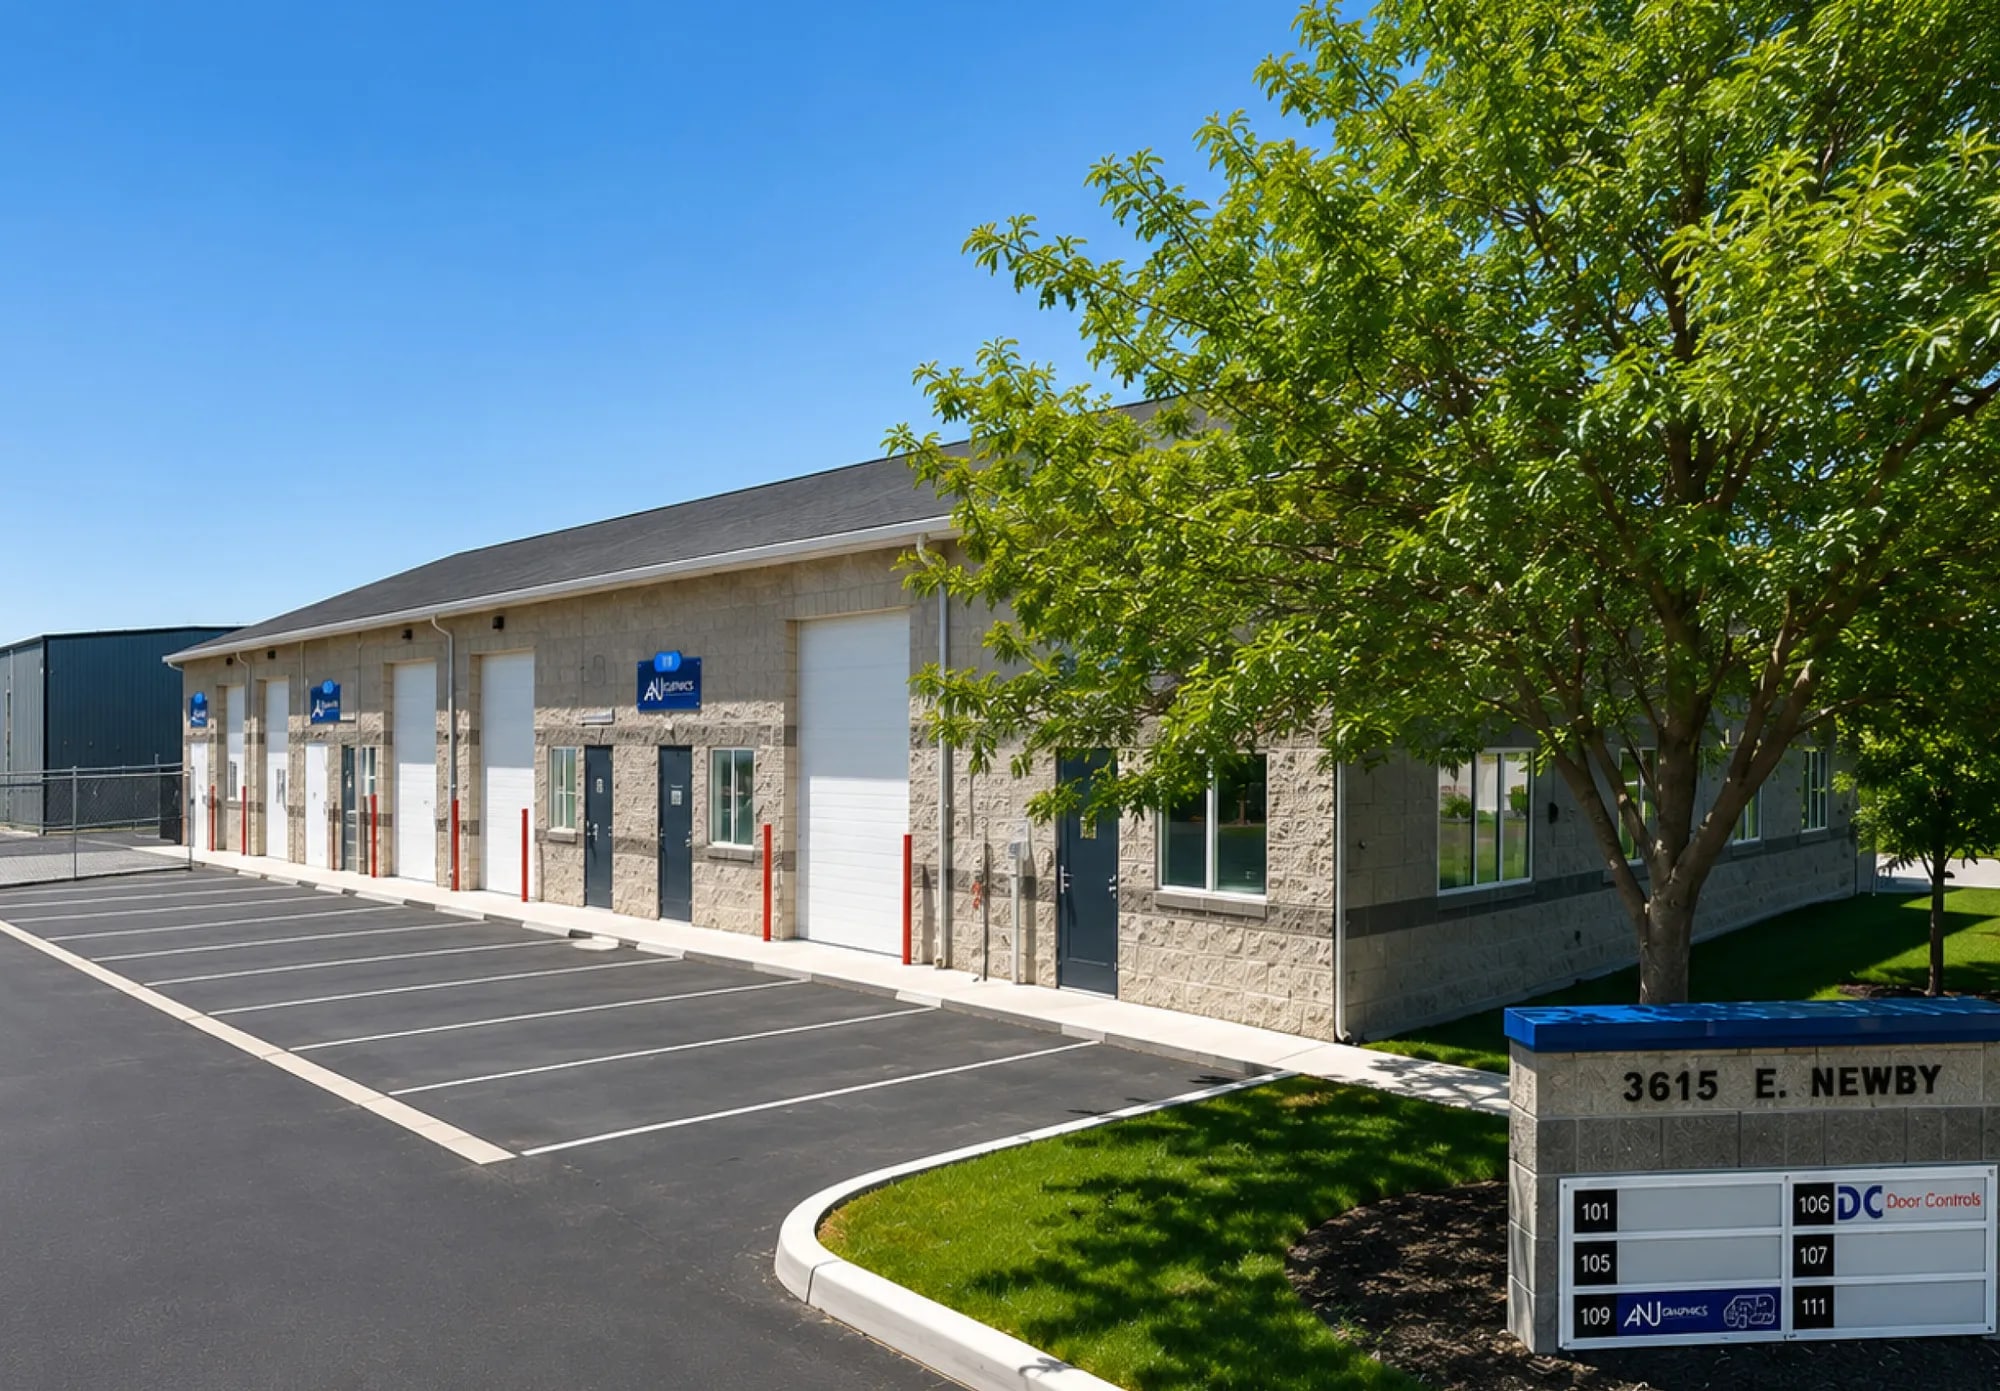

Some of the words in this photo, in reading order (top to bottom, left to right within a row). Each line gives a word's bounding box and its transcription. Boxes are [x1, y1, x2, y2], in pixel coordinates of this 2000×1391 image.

[1623, 1069, 1718, 1101] 3615
[1755, 1068, 1787, 1098] E.
[1811, 1065, 1942, 1097] NEWBY
[1582, 1202, 1609, 1221] 101
[1837, 1185, 1884, 1221] DC
[1887, 1193, 1921, 1209] Door
[1925, 1192, 1982, 1208] Controls
[1581, 1254, 1611, 1273] 105
[1800, 1246, 1828, 1265] 107
[1802, 1298, 1827, 1315] 111
[1580, 1307, 1611, 1326] 109
